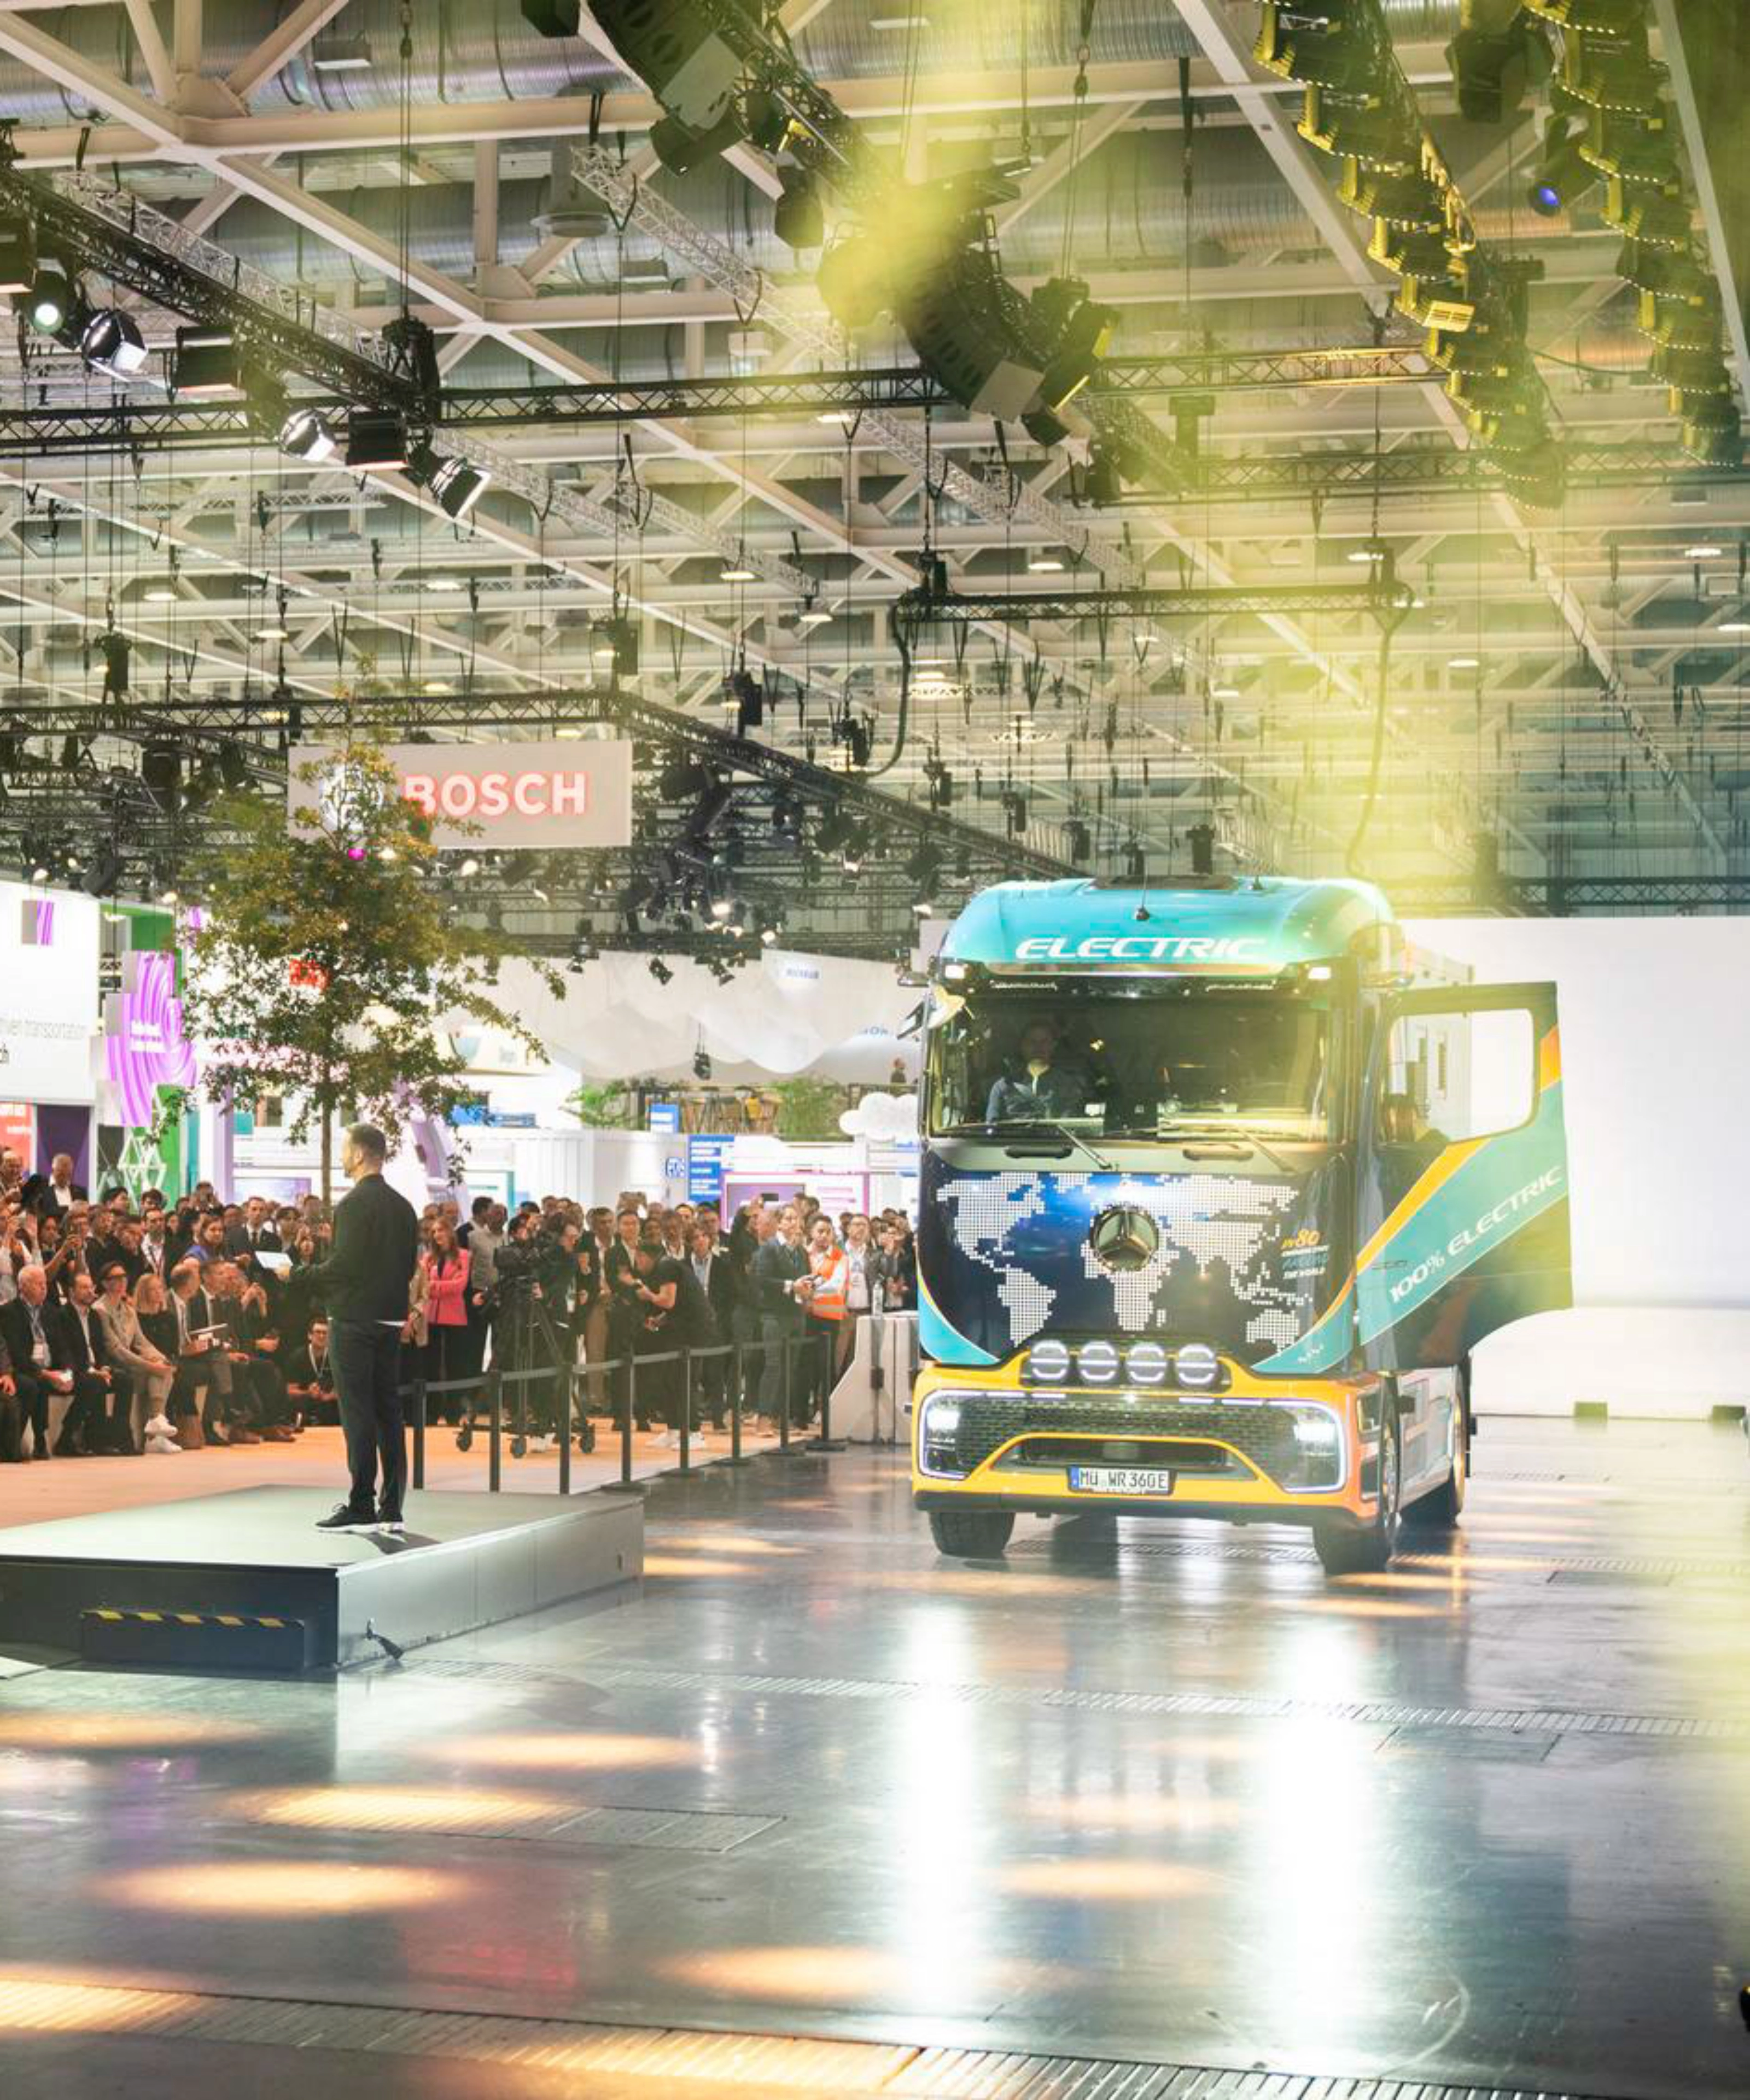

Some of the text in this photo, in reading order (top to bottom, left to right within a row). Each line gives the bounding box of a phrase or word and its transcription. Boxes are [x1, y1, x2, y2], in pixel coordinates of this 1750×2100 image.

[405, 773, 586, 816] BOSCH
[1015, 937, 1267, 959] ELECTRIC
[1296, 1229, 1320, 1247] 80
[1390, 1165, 1562, 1304] 100% ELECTRIC
